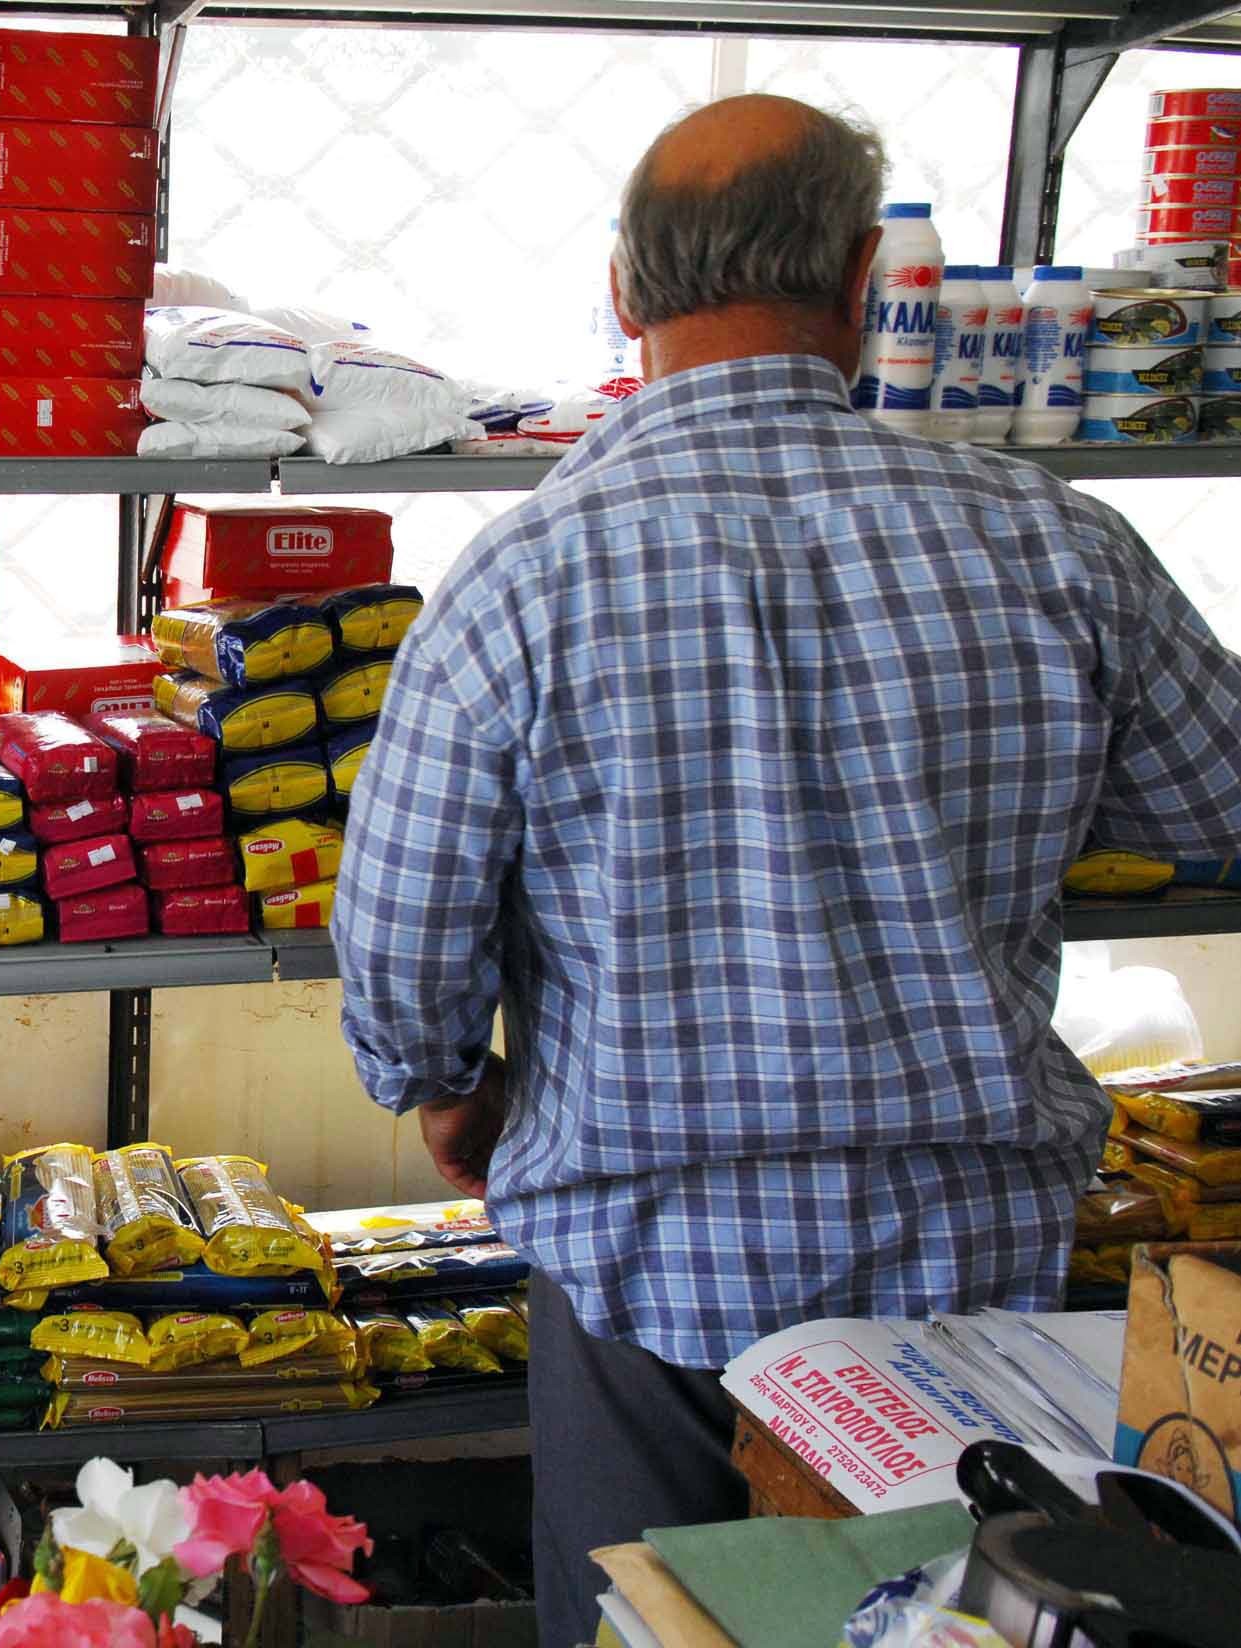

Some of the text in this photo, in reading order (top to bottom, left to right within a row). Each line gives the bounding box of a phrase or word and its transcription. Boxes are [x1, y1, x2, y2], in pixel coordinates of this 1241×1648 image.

[273, 531, 328, 551] Elite
[59, 1319, 71, 1334] 3
[791, 1368, 928, 1480] ΣΤΑΥΡΟΠΟΥΛΟΣ
[833, 1363, 939, 1441] ΕΥΑΓΓΕΛΟΣ
[769, 1390, 811, 1427] ΜΑΡΤΙΟΥ
[805, 1424, 817, 1435] 8
[826, 1444, 859, 1474] 27520
[854, 1469, 888, 1499] 23472
